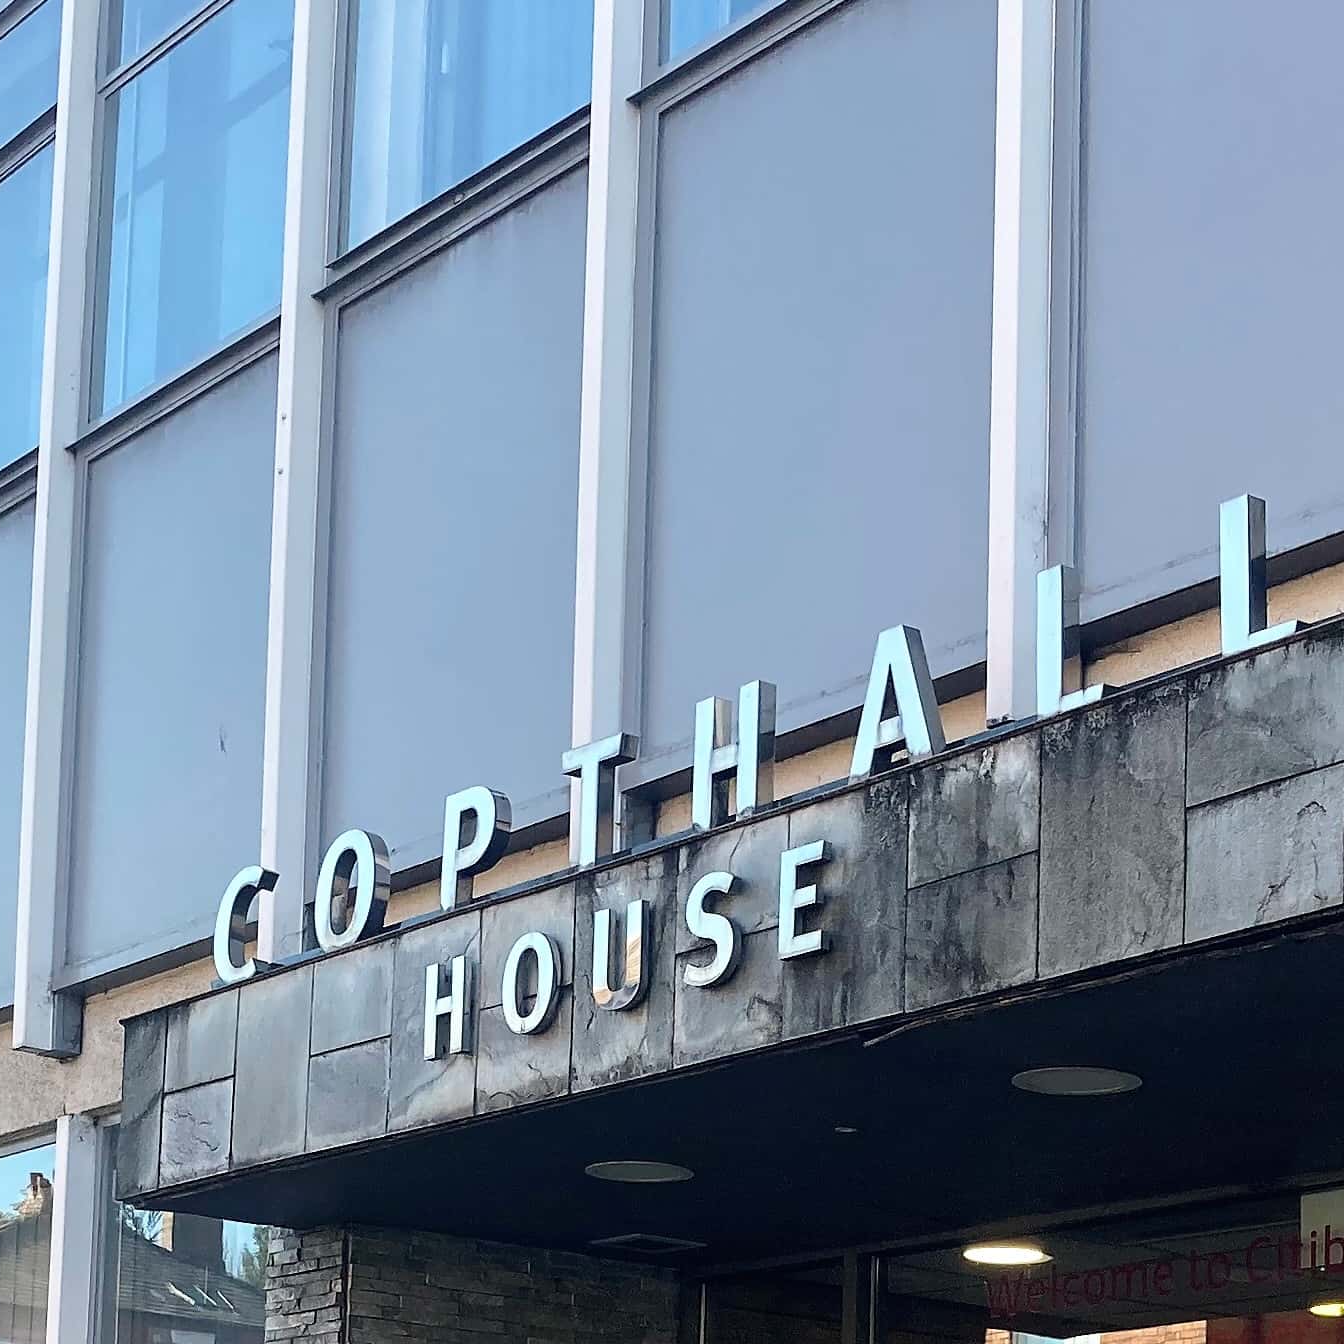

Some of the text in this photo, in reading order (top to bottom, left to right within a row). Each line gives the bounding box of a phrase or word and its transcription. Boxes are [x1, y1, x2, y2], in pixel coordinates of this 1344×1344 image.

[212, 492, 1303, 986] COPTHALL
[422, 838, 832, 1061] HOUSE
[985, 1255, 1173, 1315] Welcome
[1188, 1245, 1232, 1292] to
